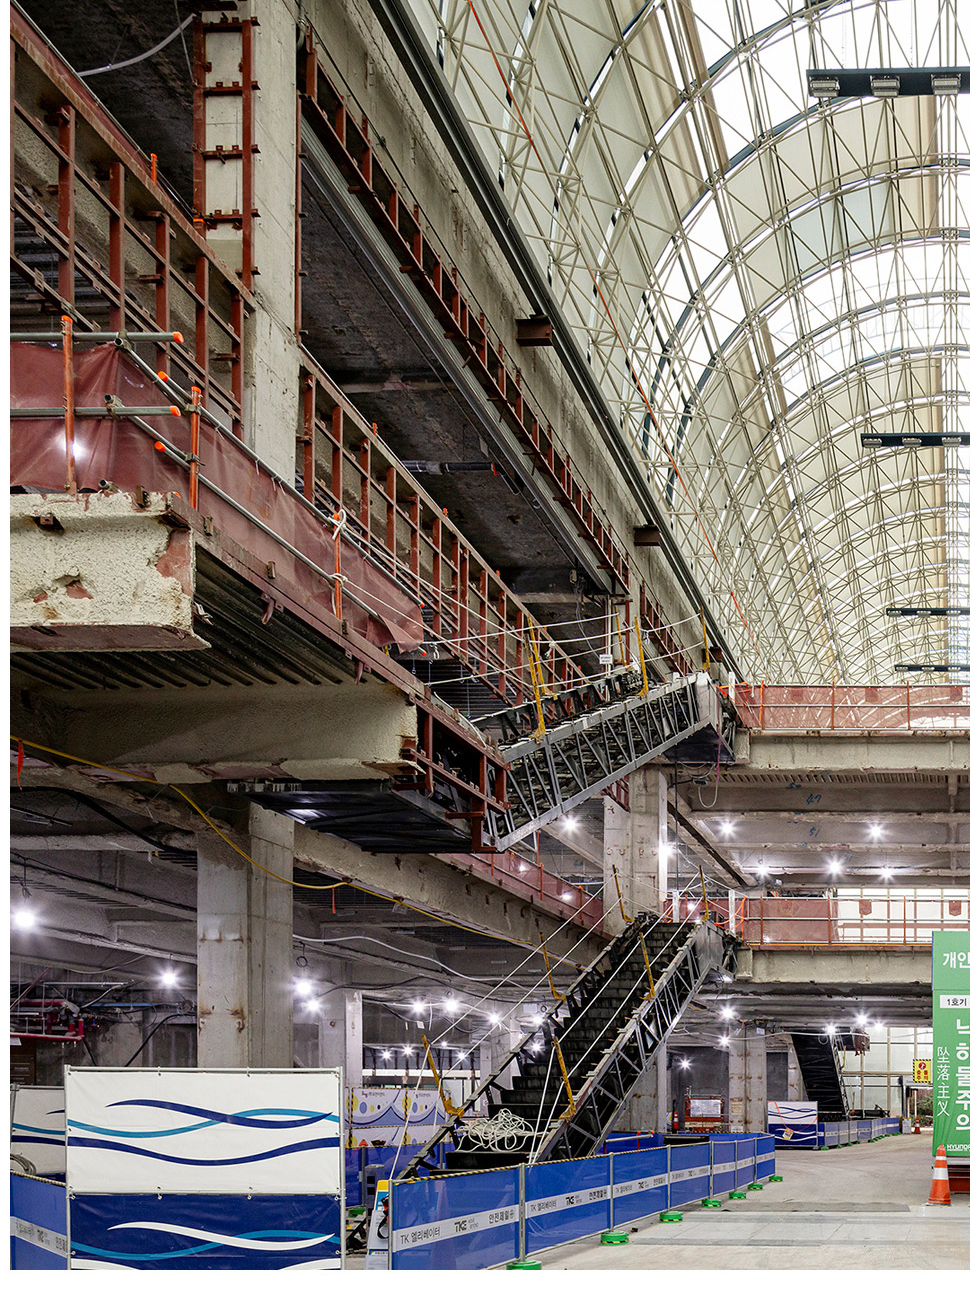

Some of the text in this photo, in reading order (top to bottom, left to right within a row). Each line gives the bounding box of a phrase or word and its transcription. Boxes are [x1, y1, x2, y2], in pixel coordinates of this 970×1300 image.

[946, 998, 968, 1007] 1호기
[400, 1234, 410, 1245] TK
[410, 1226, 441, 1243] 엘리베이터
[488, 1210, 510, 1224] 안전제일
